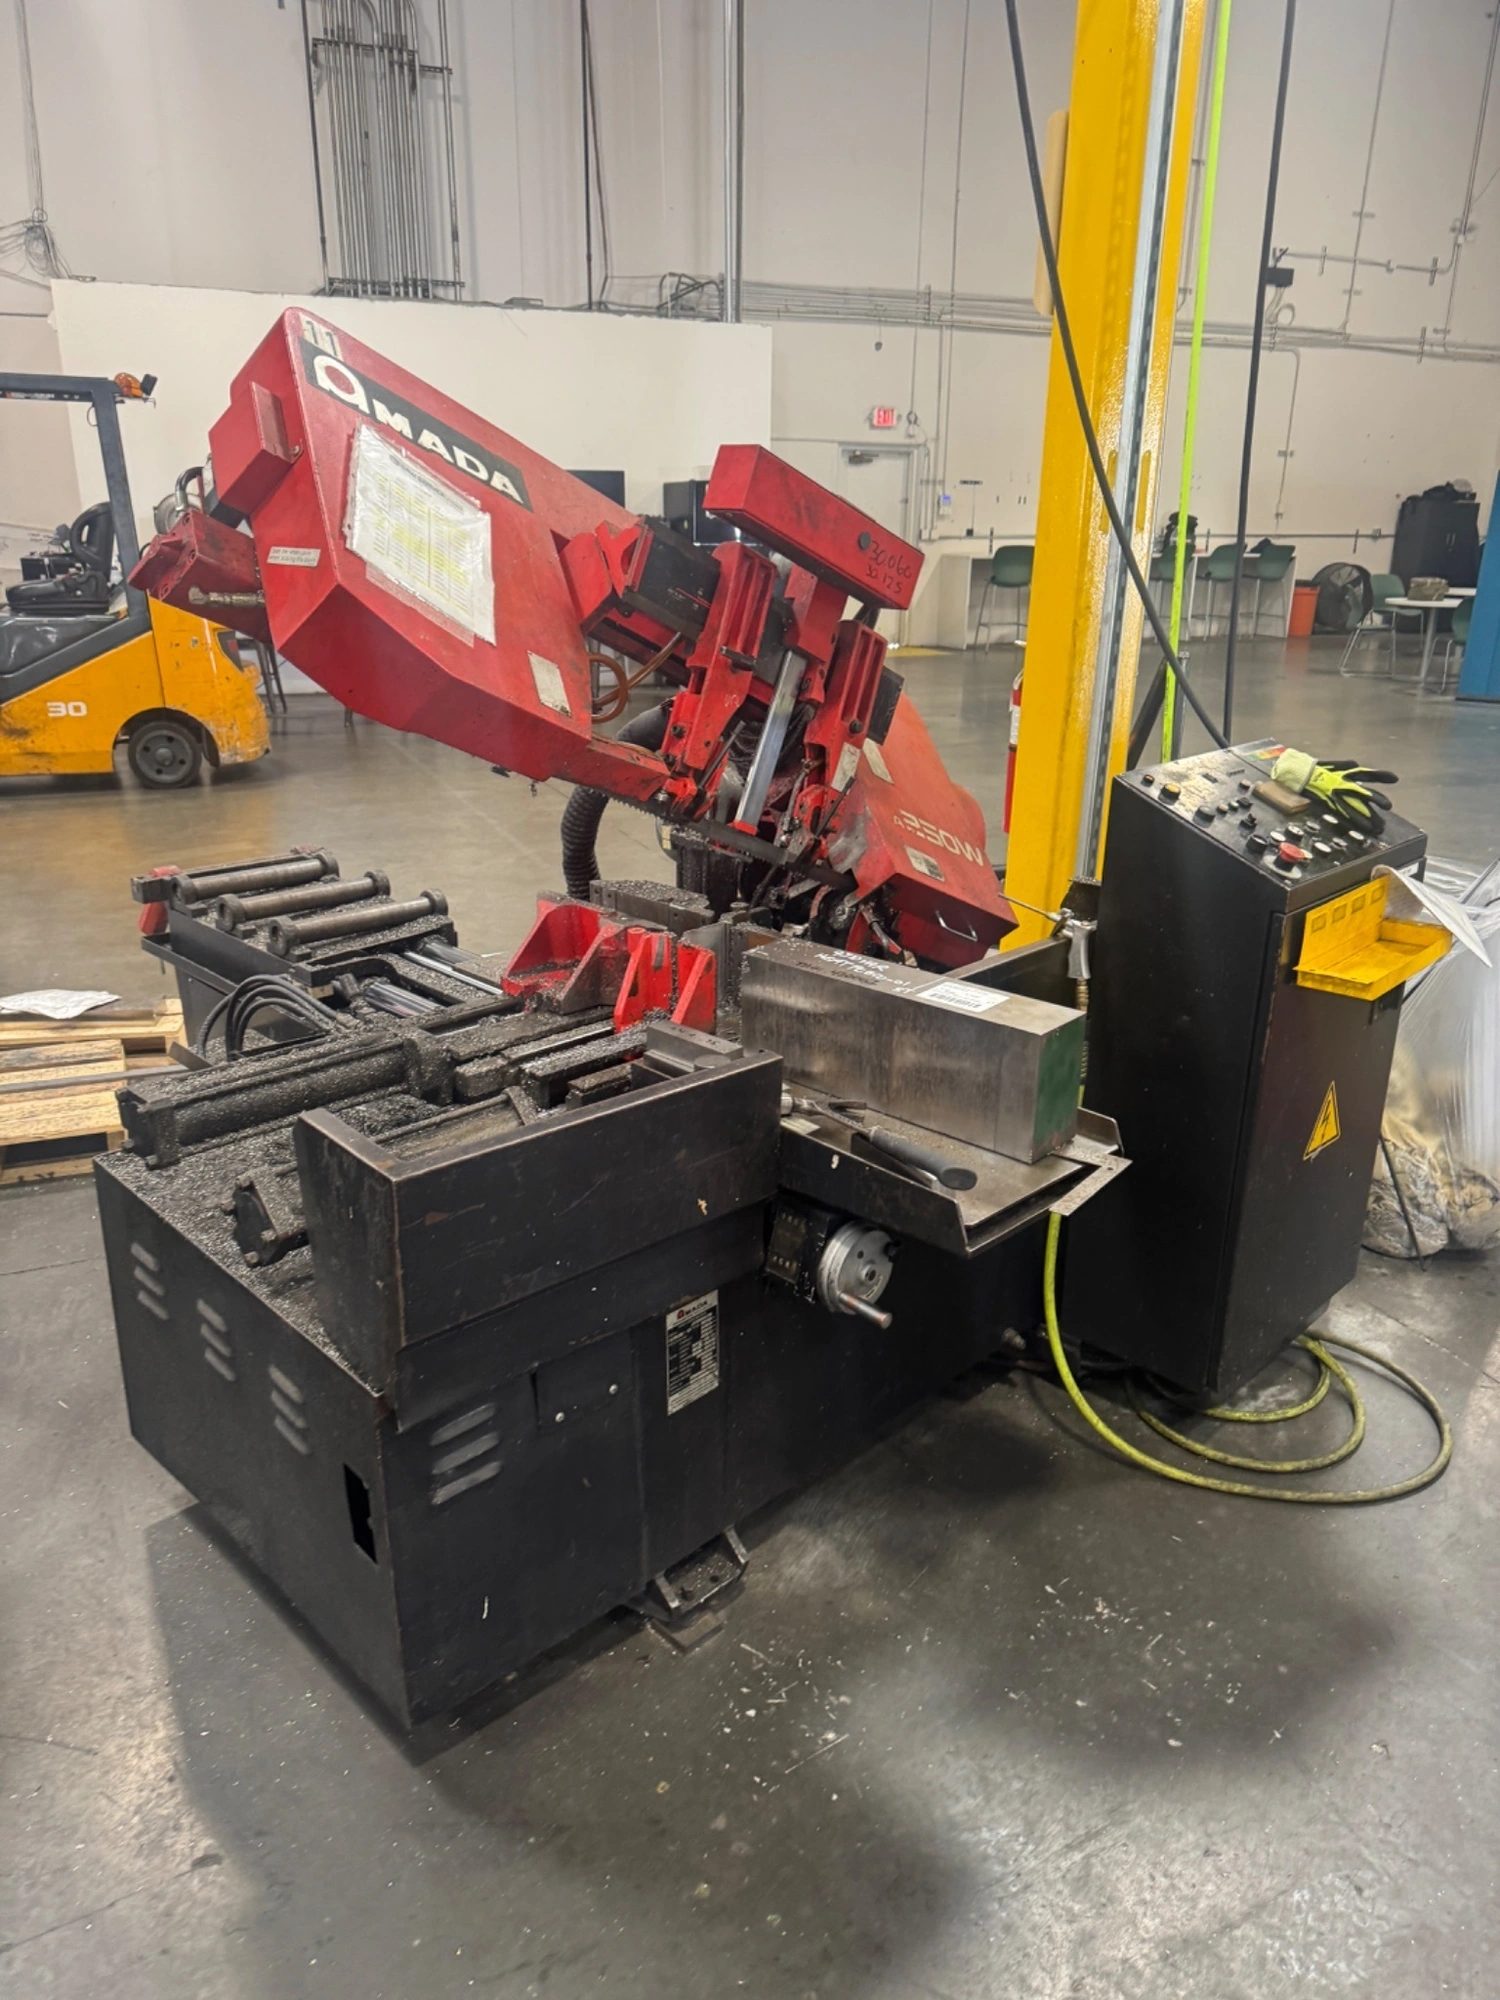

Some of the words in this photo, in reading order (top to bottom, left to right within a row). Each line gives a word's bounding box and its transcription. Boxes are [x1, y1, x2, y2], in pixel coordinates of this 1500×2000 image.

[876, 407, 895, 425] EXIT
[313, 355, 523, 503] AMADA
[46, 701, 88, 717] 30
